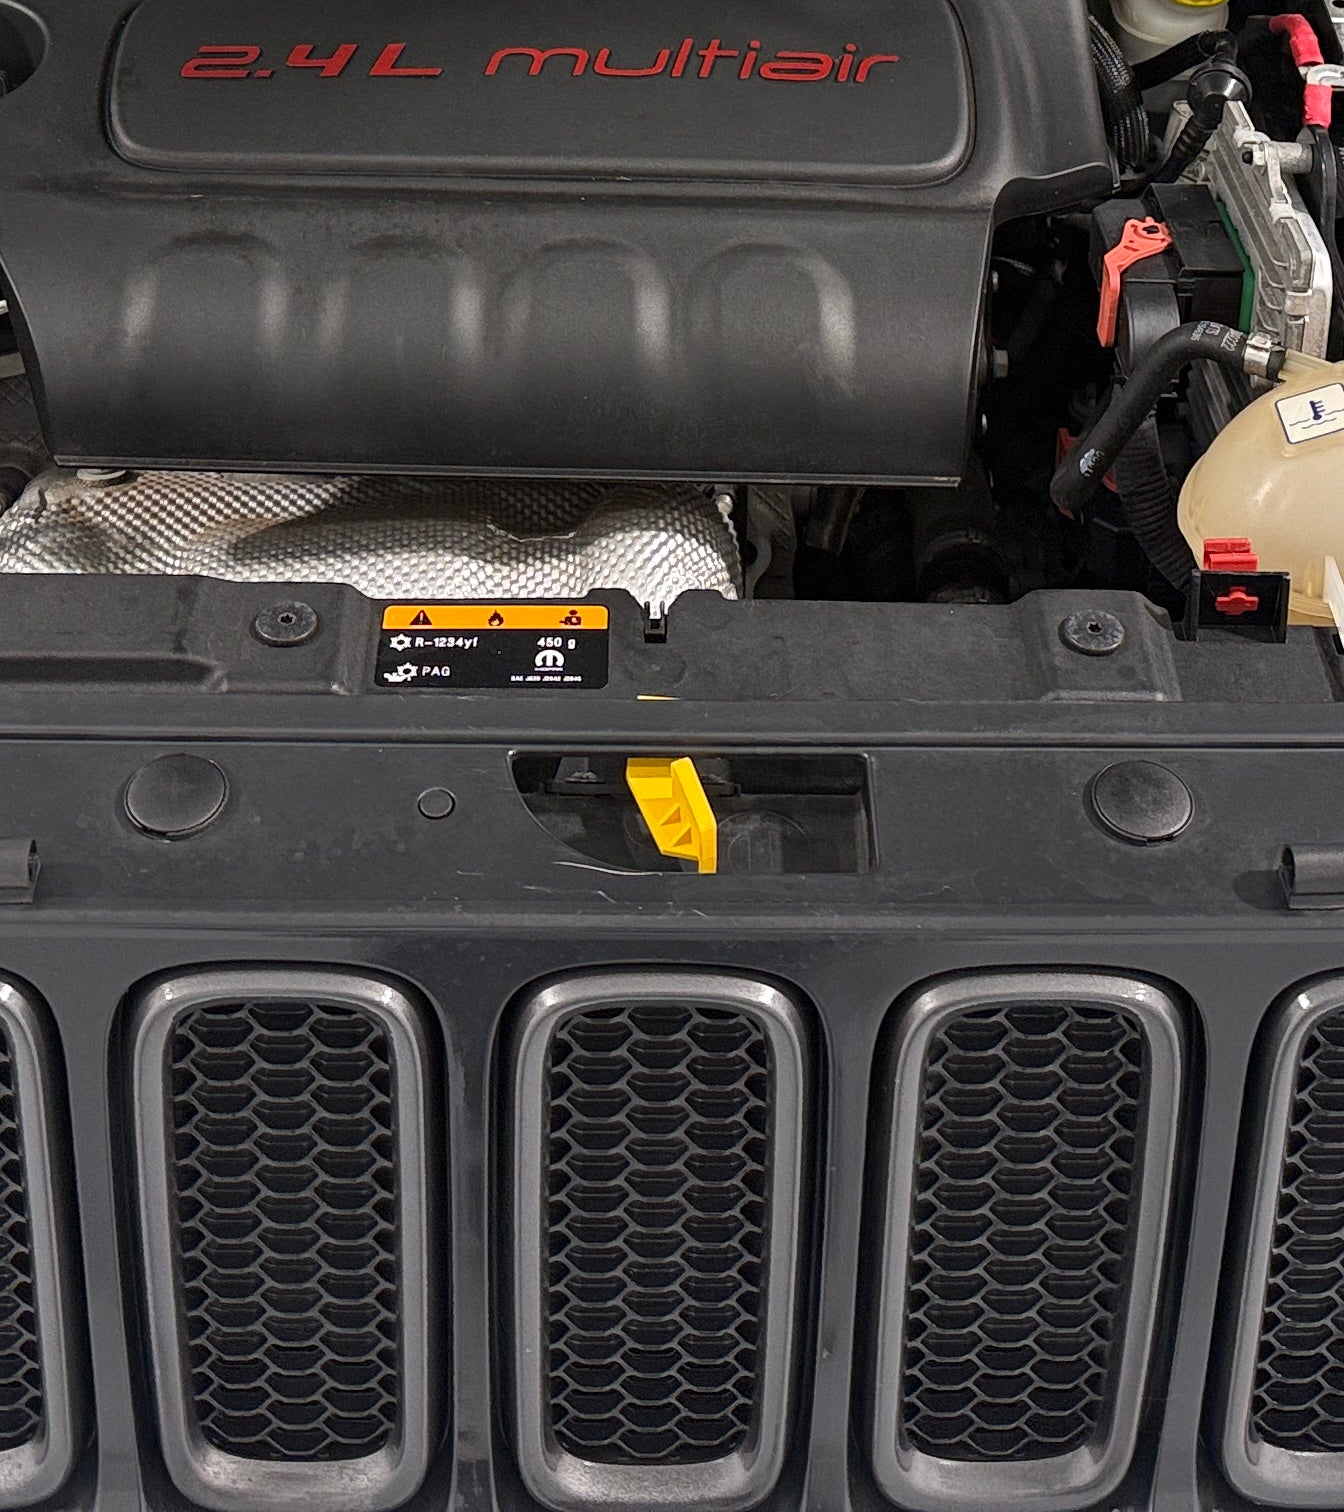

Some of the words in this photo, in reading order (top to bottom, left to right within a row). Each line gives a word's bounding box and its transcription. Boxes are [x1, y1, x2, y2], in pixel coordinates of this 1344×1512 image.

[485, 38, 900, 84] multiair
[415, 637, 478, 649] R-1234yf
[537, 637, 563, 648] 450
[422, 666, 451, 677] PAG
